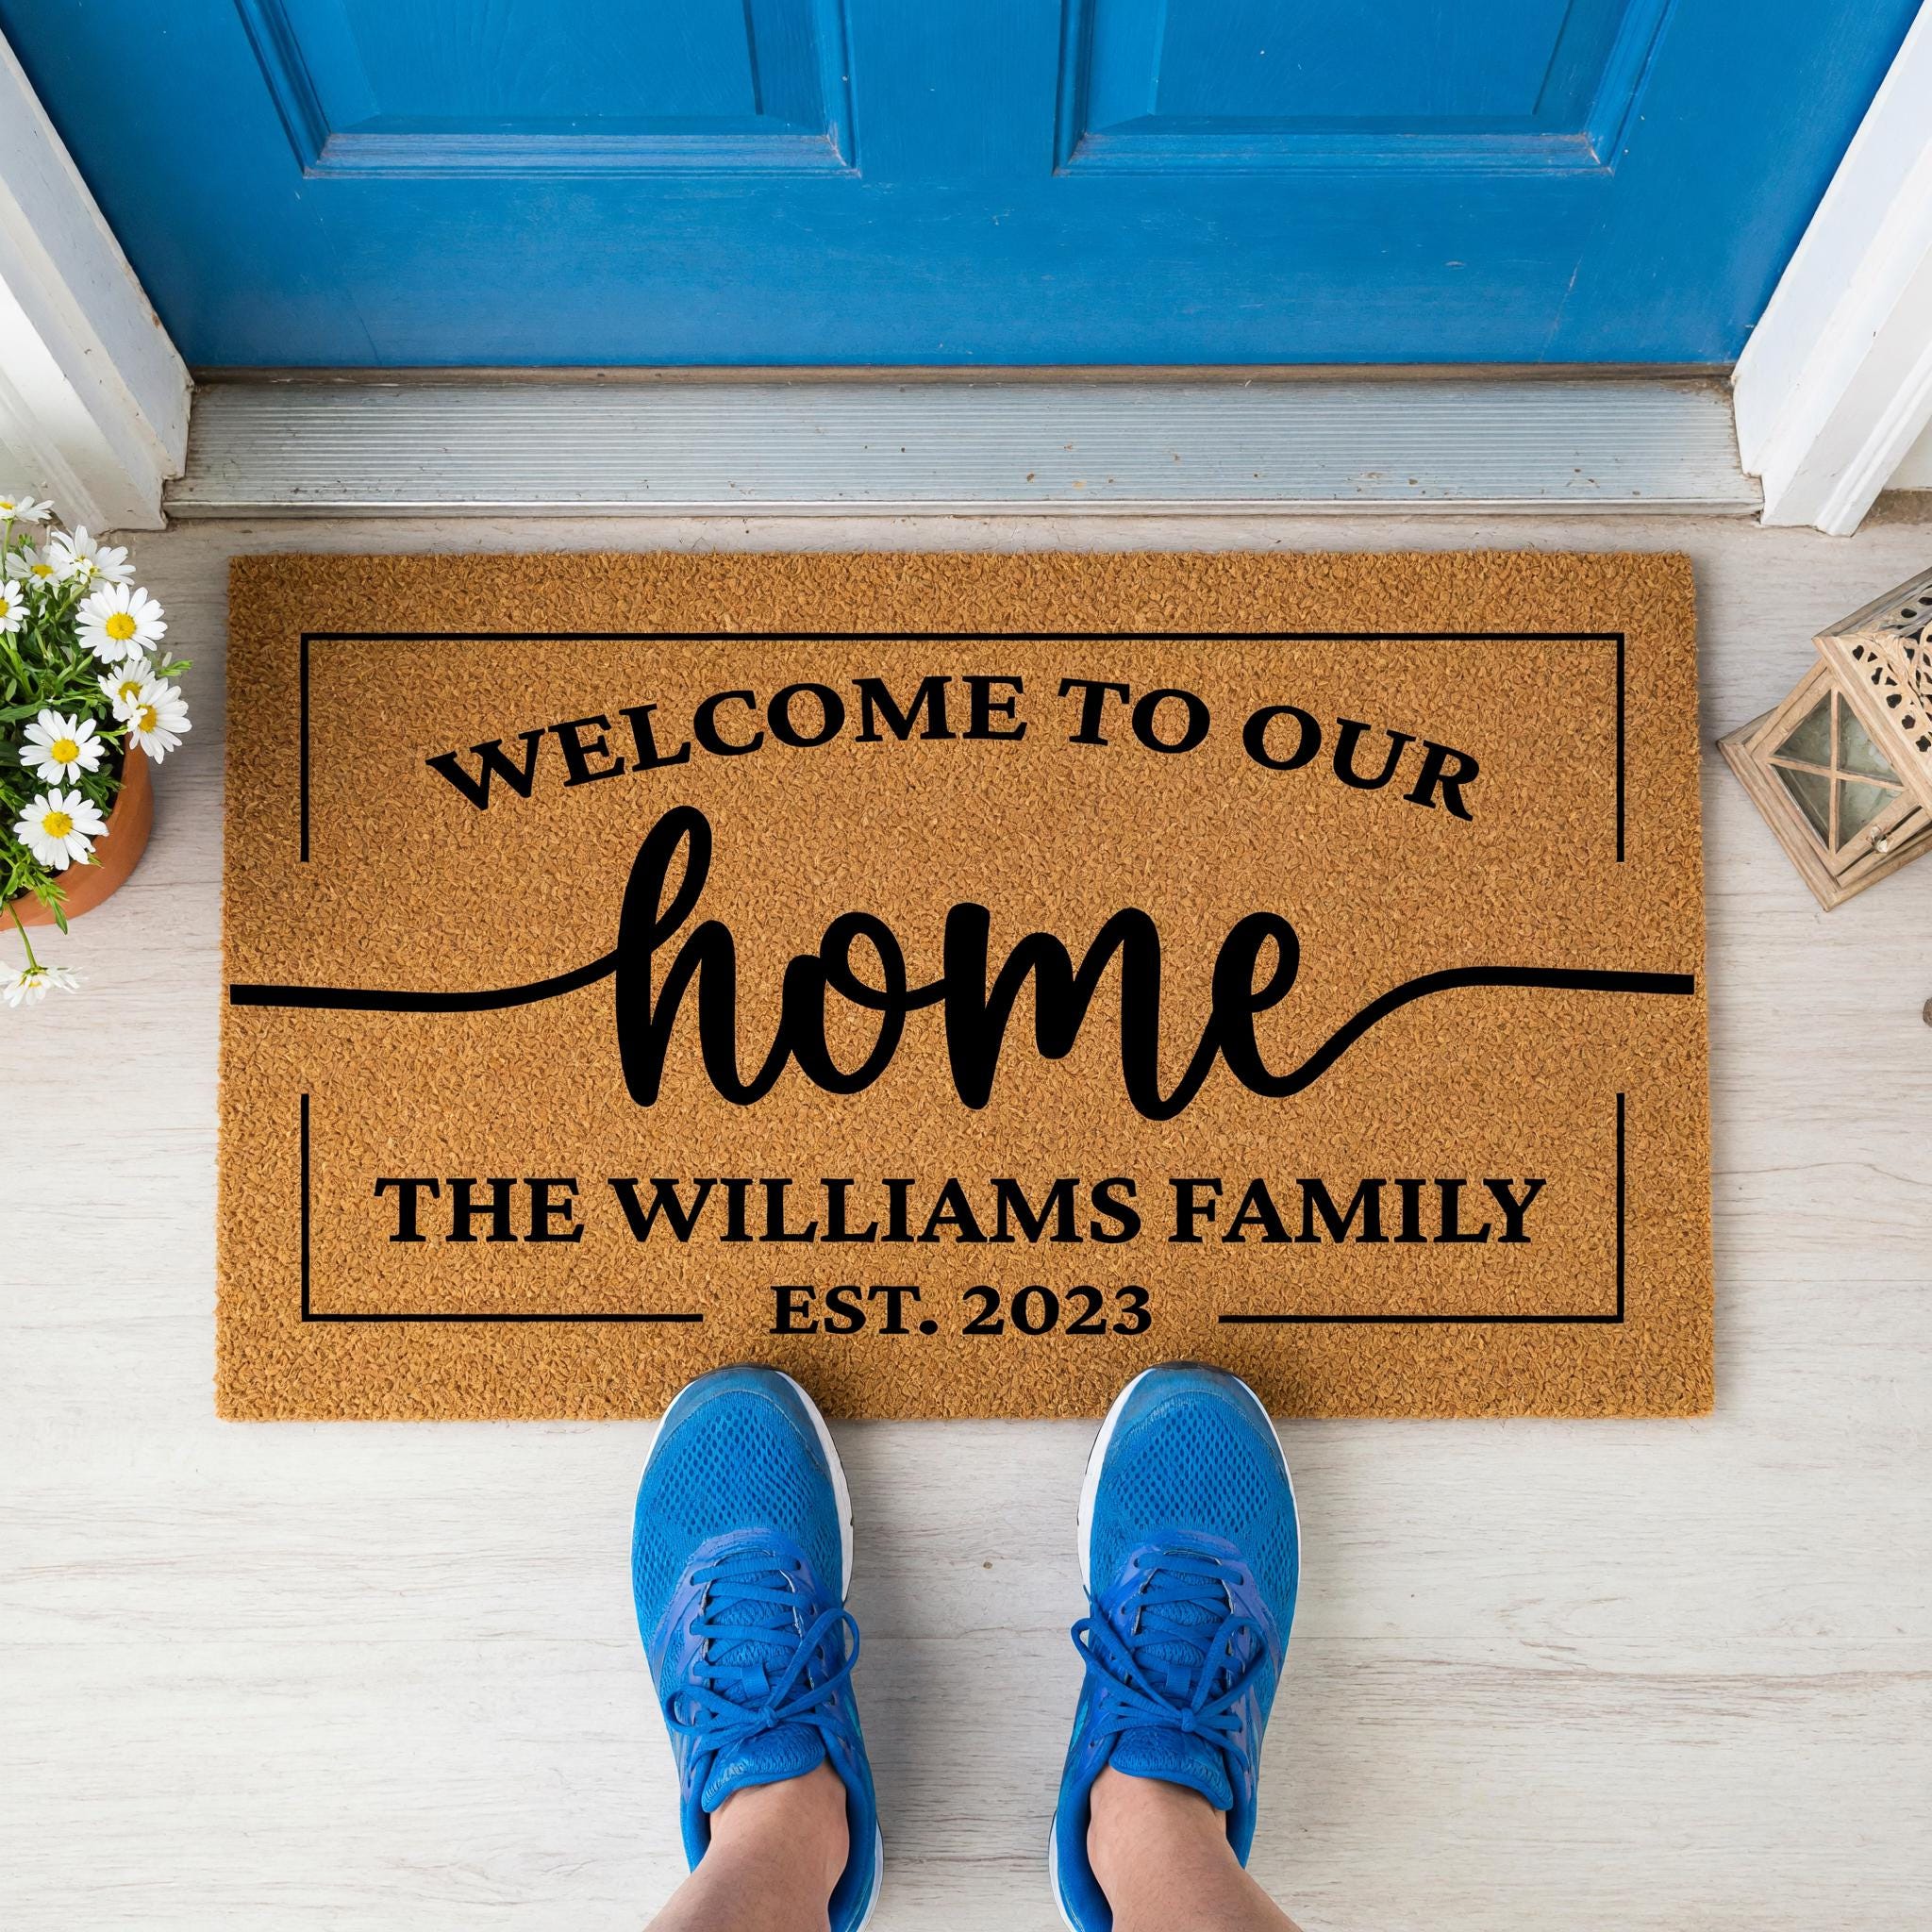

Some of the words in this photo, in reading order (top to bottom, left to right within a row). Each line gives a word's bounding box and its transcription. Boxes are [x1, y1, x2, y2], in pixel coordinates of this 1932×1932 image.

[425, 675, 1027, 811] WELCOME
[1058, 677, 1210, 754] TO
[1242, 705, 1480, 822] OUR
[585, 806, 1358, 1121] home
[374, 1177, 585, 1243] THE
[608, 1176, 1141, 1244] WILLIAMS
[1168, 1177, 1547, 1243] FAMILY
[769, 1285, 938, 1336] EST.
[962, 1285, 1152, 1336] 2023
